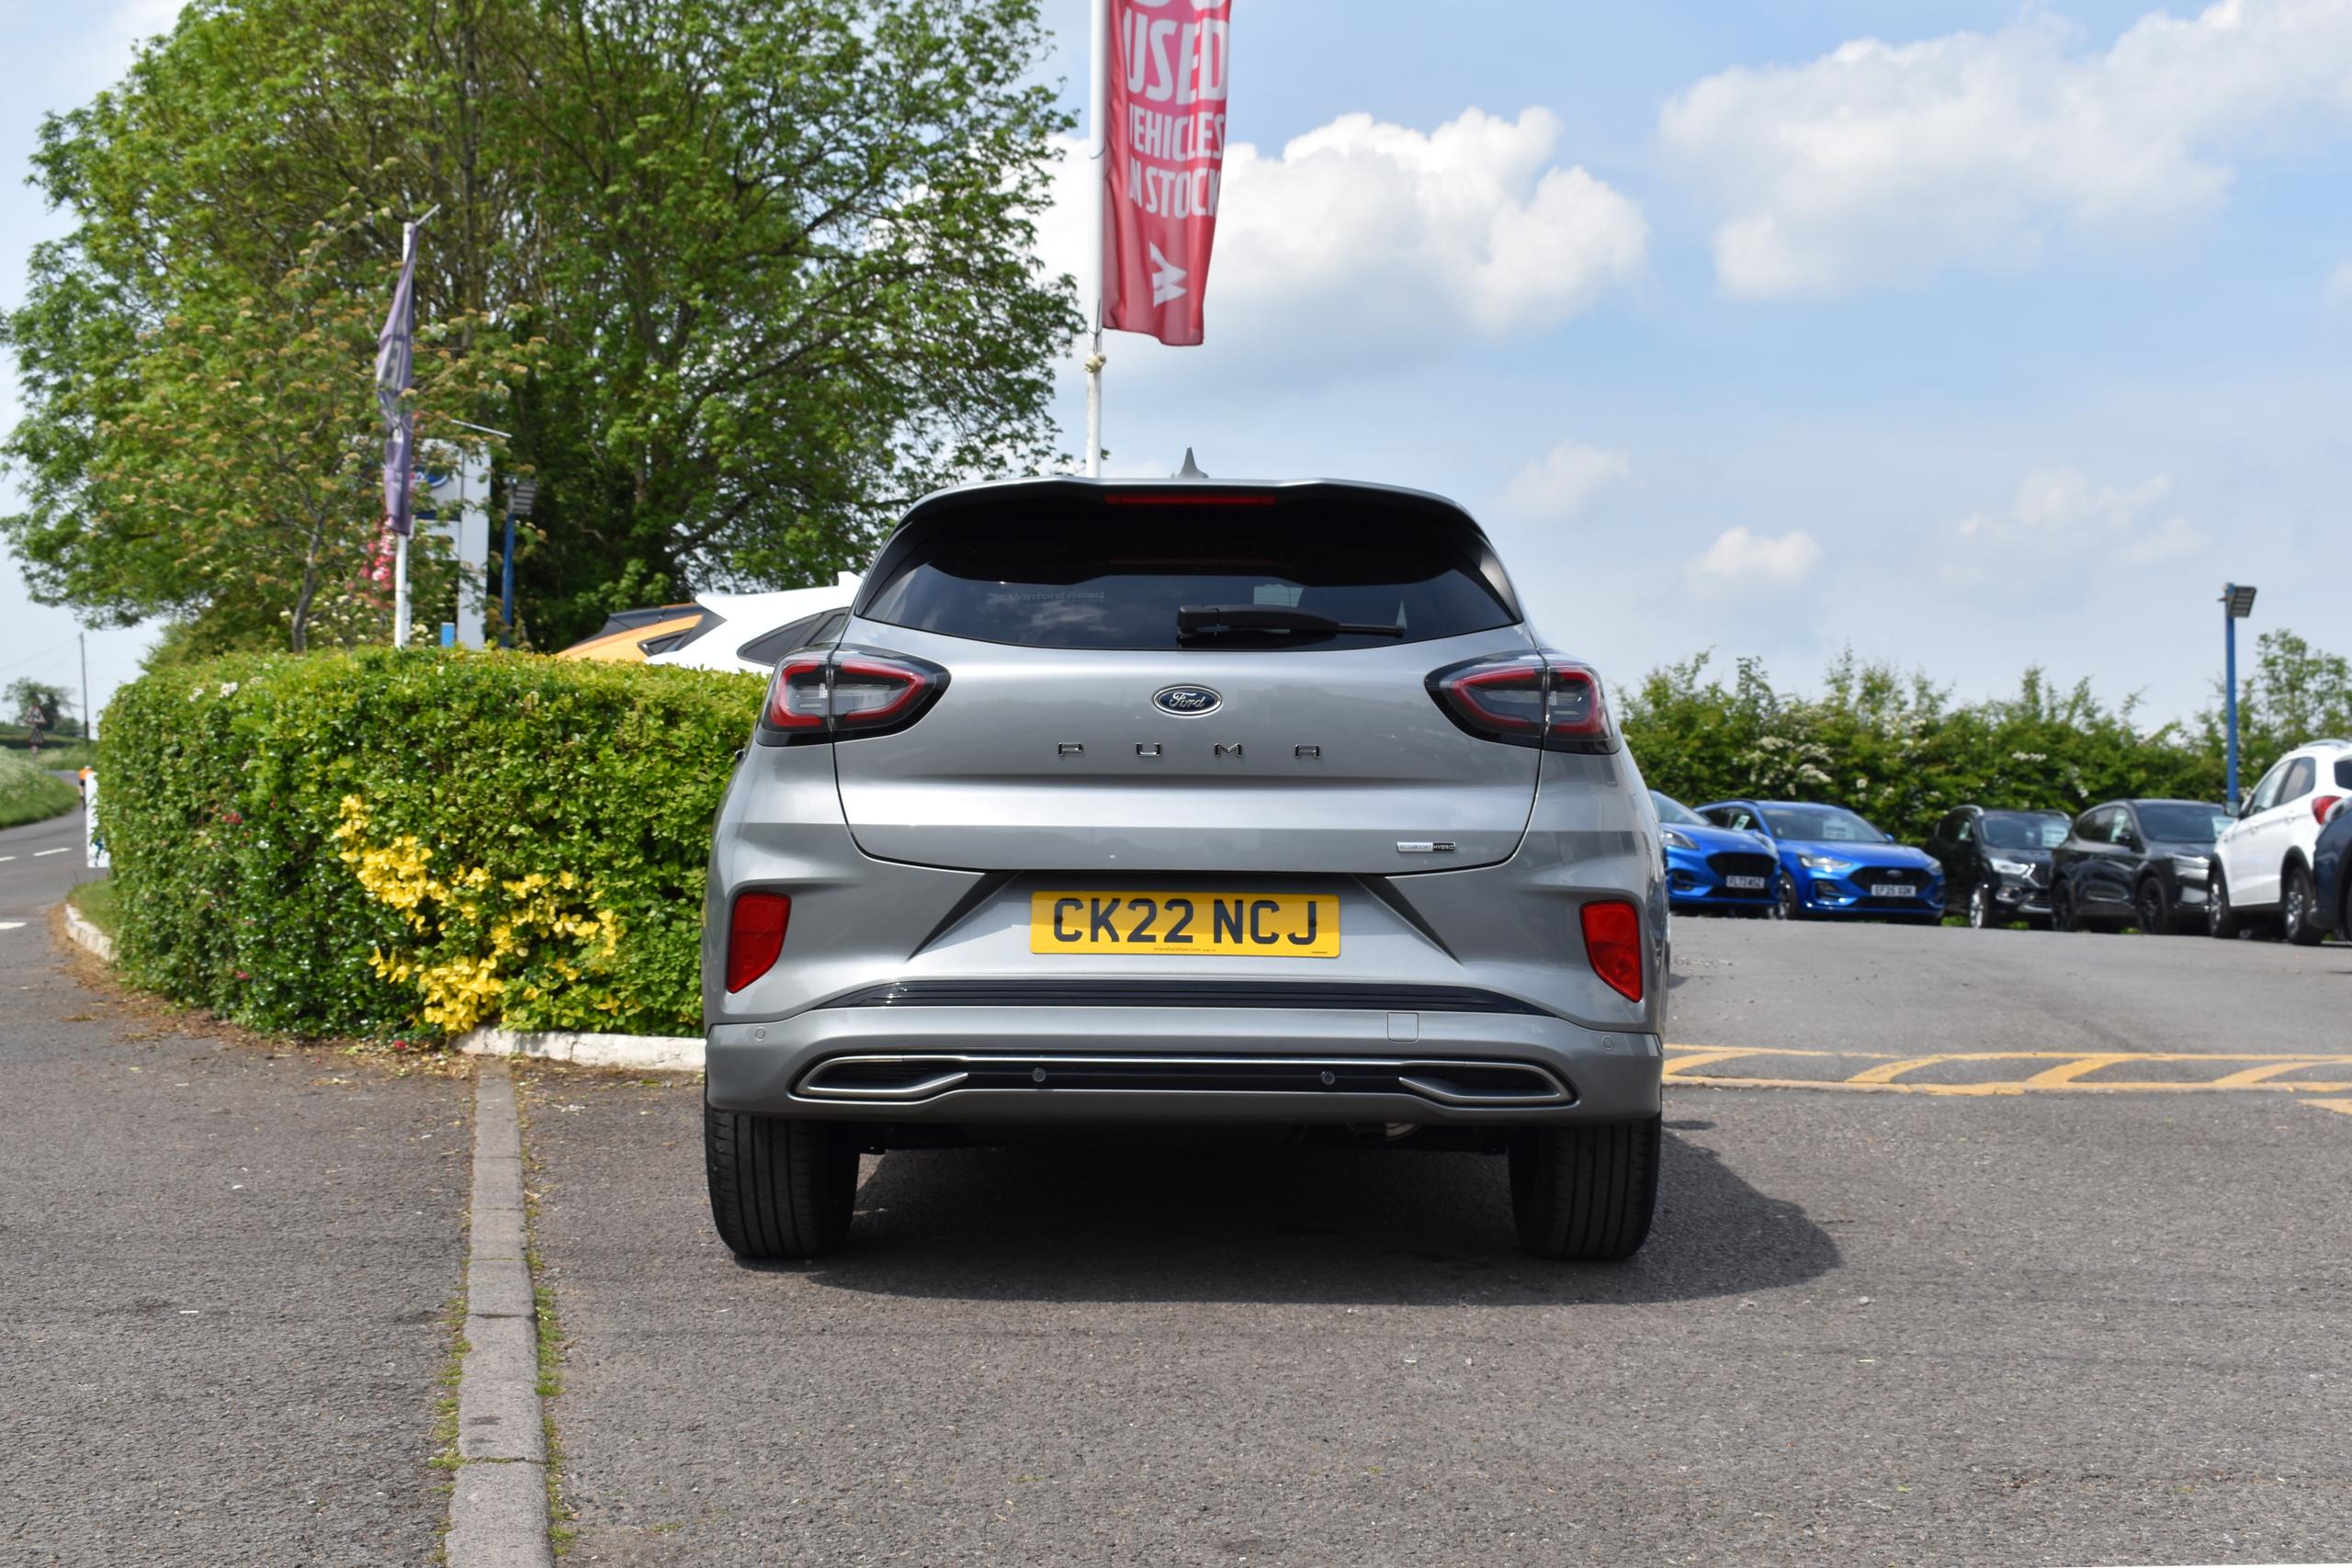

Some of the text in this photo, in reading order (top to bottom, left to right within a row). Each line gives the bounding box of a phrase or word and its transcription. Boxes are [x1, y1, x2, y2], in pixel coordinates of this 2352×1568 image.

[1124, 7, 1229, 105] USED
[1169, 692, 1206, 708] Ford
[1057, 742, 1320, 759] PUMA
[1053, 897, 1317, 946] CK22 NCJ
